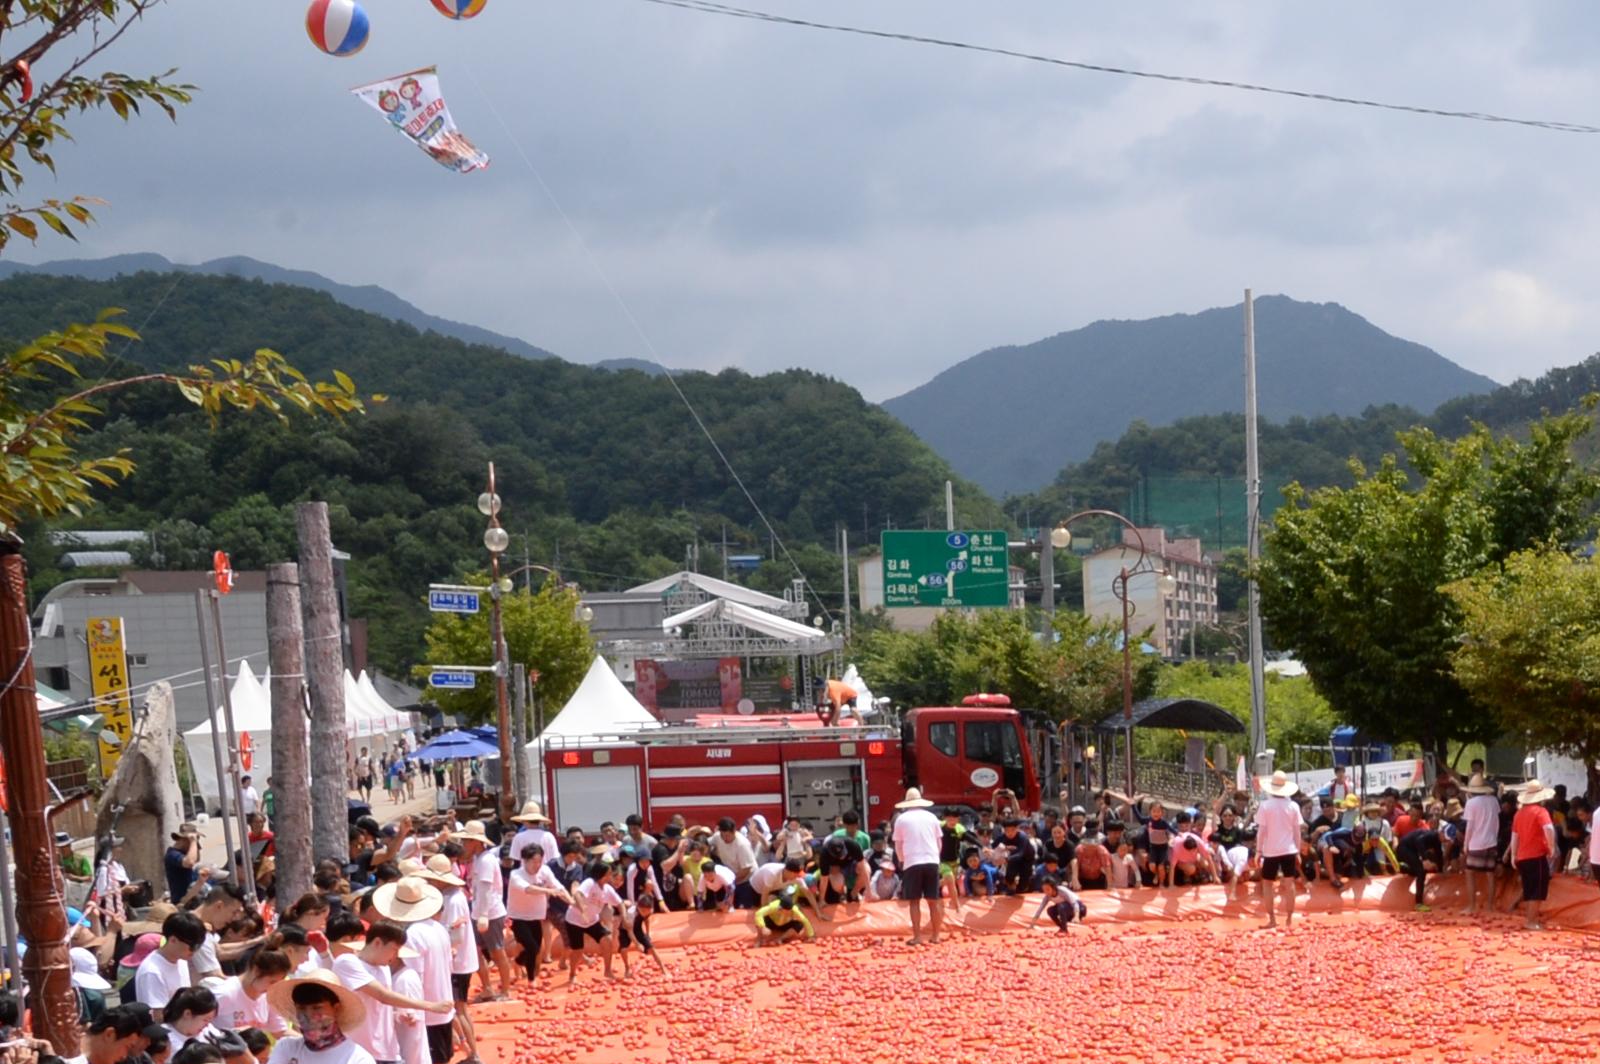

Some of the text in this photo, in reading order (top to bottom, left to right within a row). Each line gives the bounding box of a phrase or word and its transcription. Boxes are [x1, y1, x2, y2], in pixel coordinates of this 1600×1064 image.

[953, 535, 961, 545] 5
[951, 561, 964, 570] 56
[929, 576, 942, 585] 56
